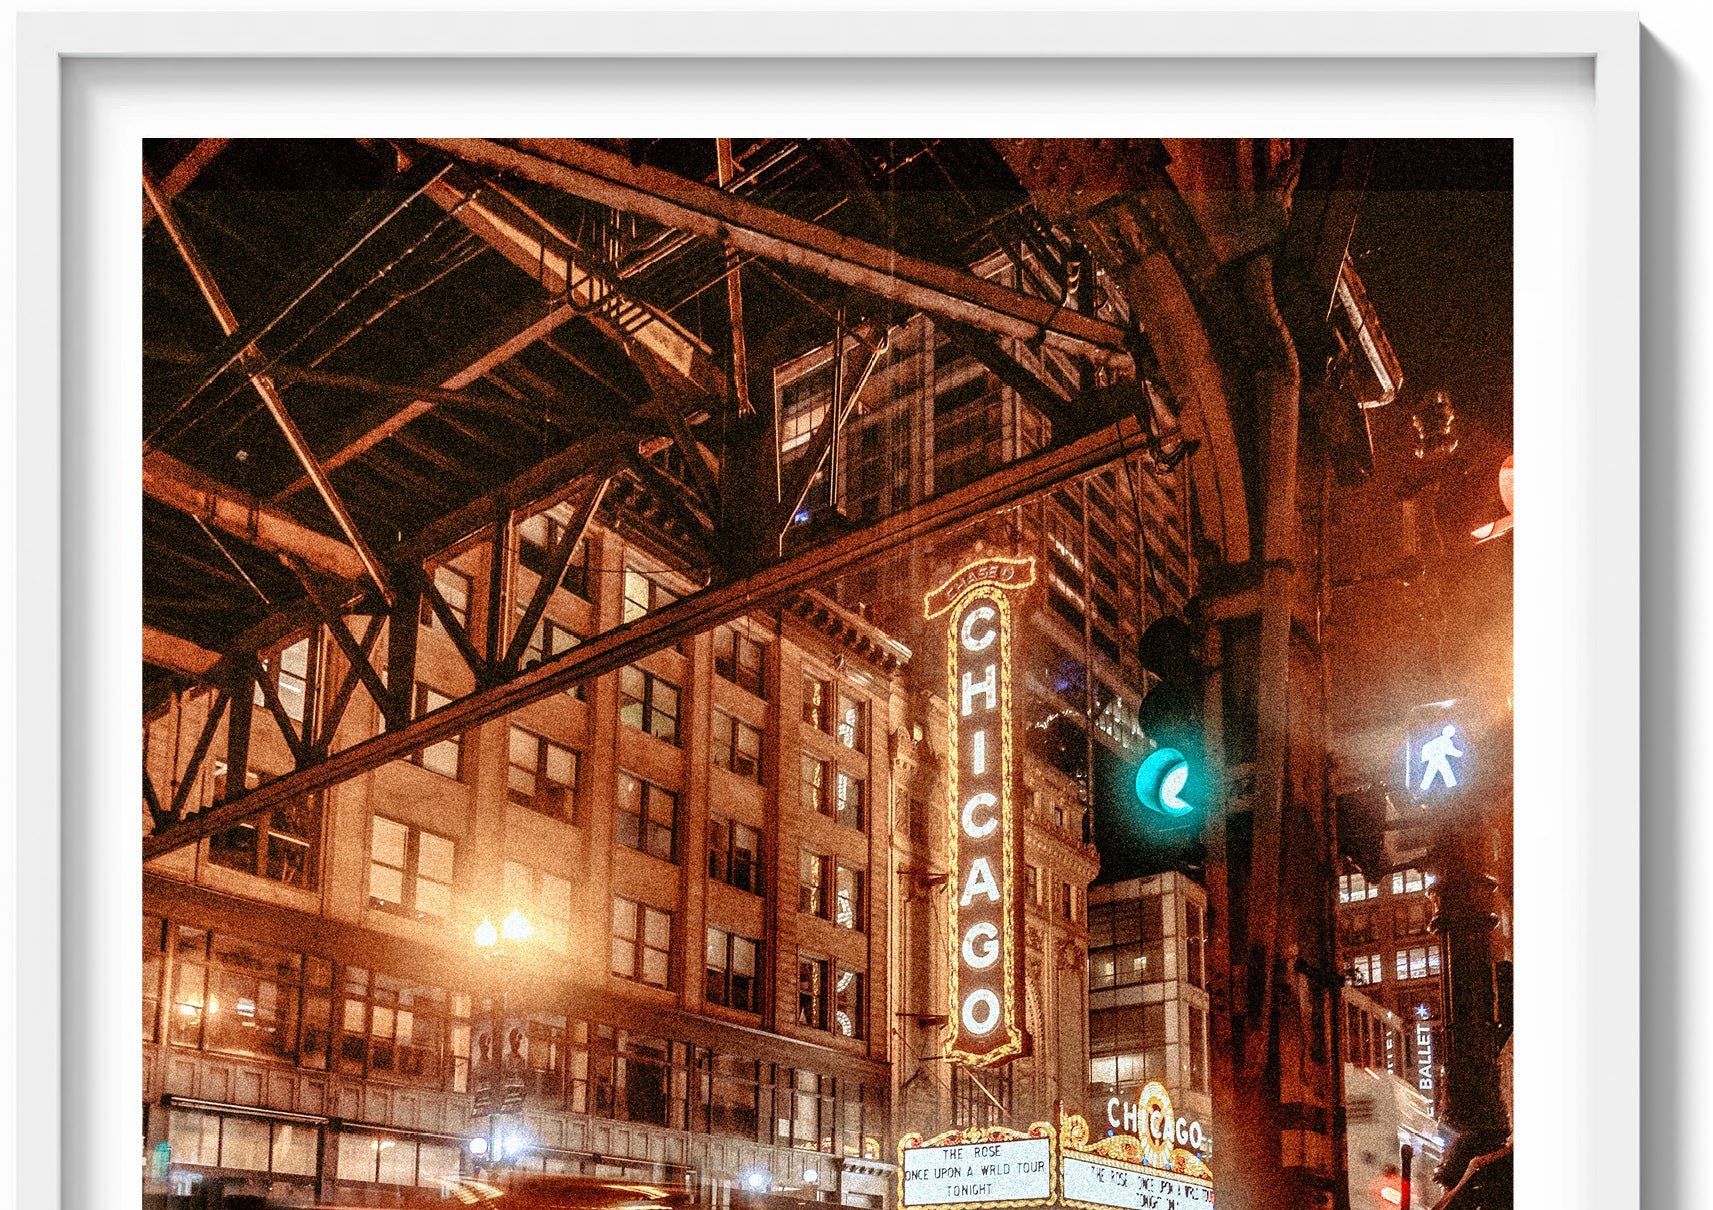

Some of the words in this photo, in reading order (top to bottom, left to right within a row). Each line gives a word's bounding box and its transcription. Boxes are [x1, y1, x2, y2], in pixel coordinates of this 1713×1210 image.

[946, 565, 999, 601] CHASE
[960, 606, 1002, 1035] CHICAGO
[1416, 1024, 1434, 1089] BALLET
[1107, 1097, 1202, 1149] CHICAGO
[942, 1147, 964, 1160] THE
[974, 1144, 1001, 1158] ROSE
[905, 1168, 929, 1181] ONCE
[934, 1166, 961, 1179] UPON
[966, 1166, 974, 1177] A
[980, 1163, 1011, 1176] WRLD
[1016, 1160, 1046, 1174] TOUR
[947, 1182, 993, 1197] TONIGHT
